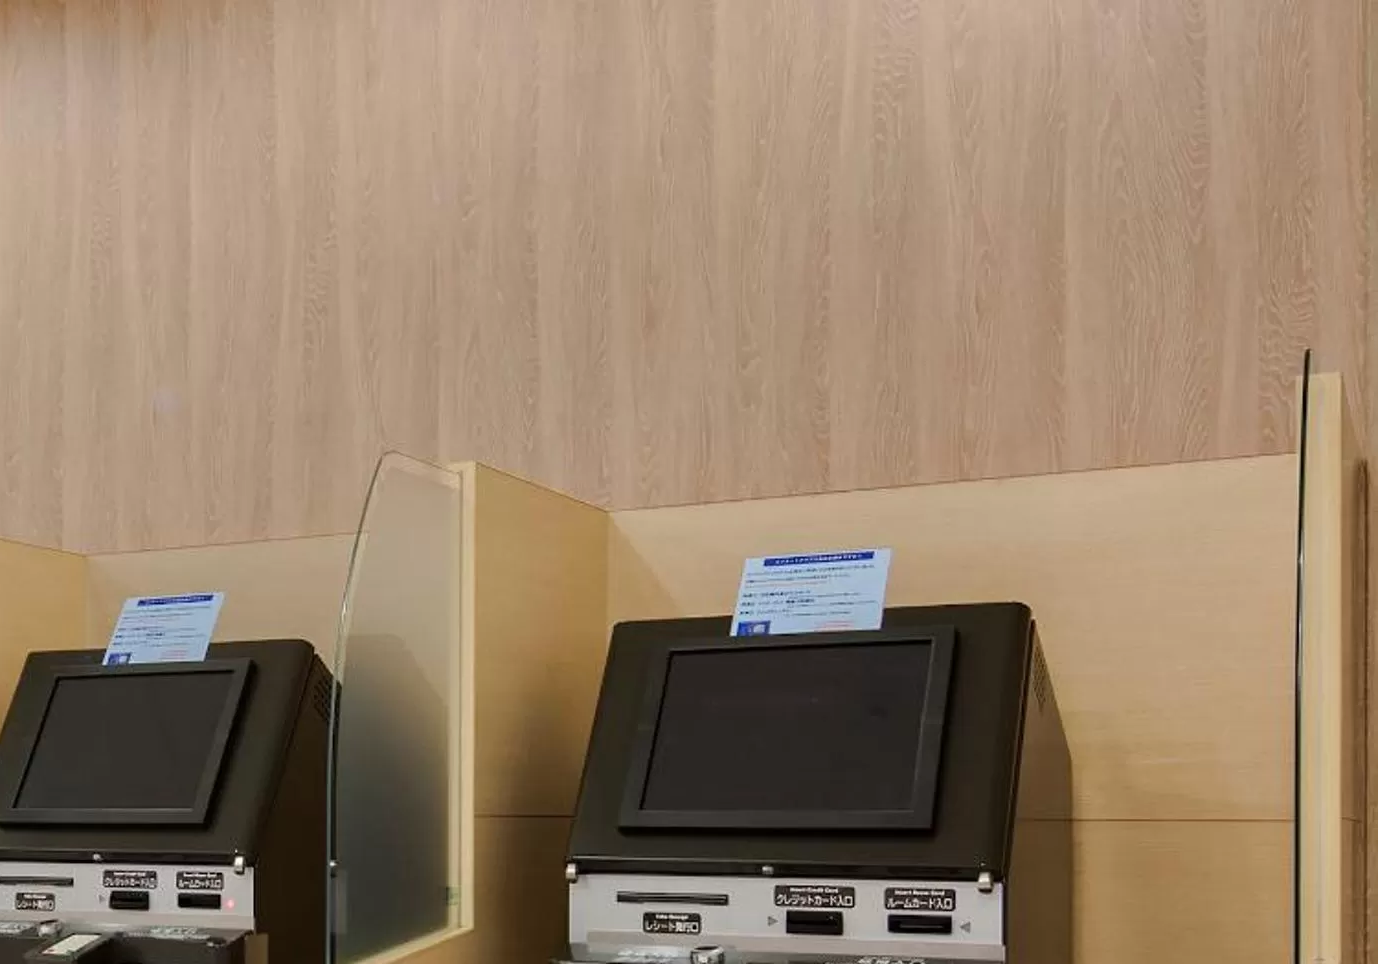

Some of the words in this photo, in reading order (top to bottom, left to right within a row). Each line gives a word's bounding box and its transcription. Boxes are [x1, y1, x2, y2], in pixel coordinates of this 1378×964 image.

[776, 893, 854, 906] クレジットカード入口
[887, 897, 953, 910] ルームカード入口
